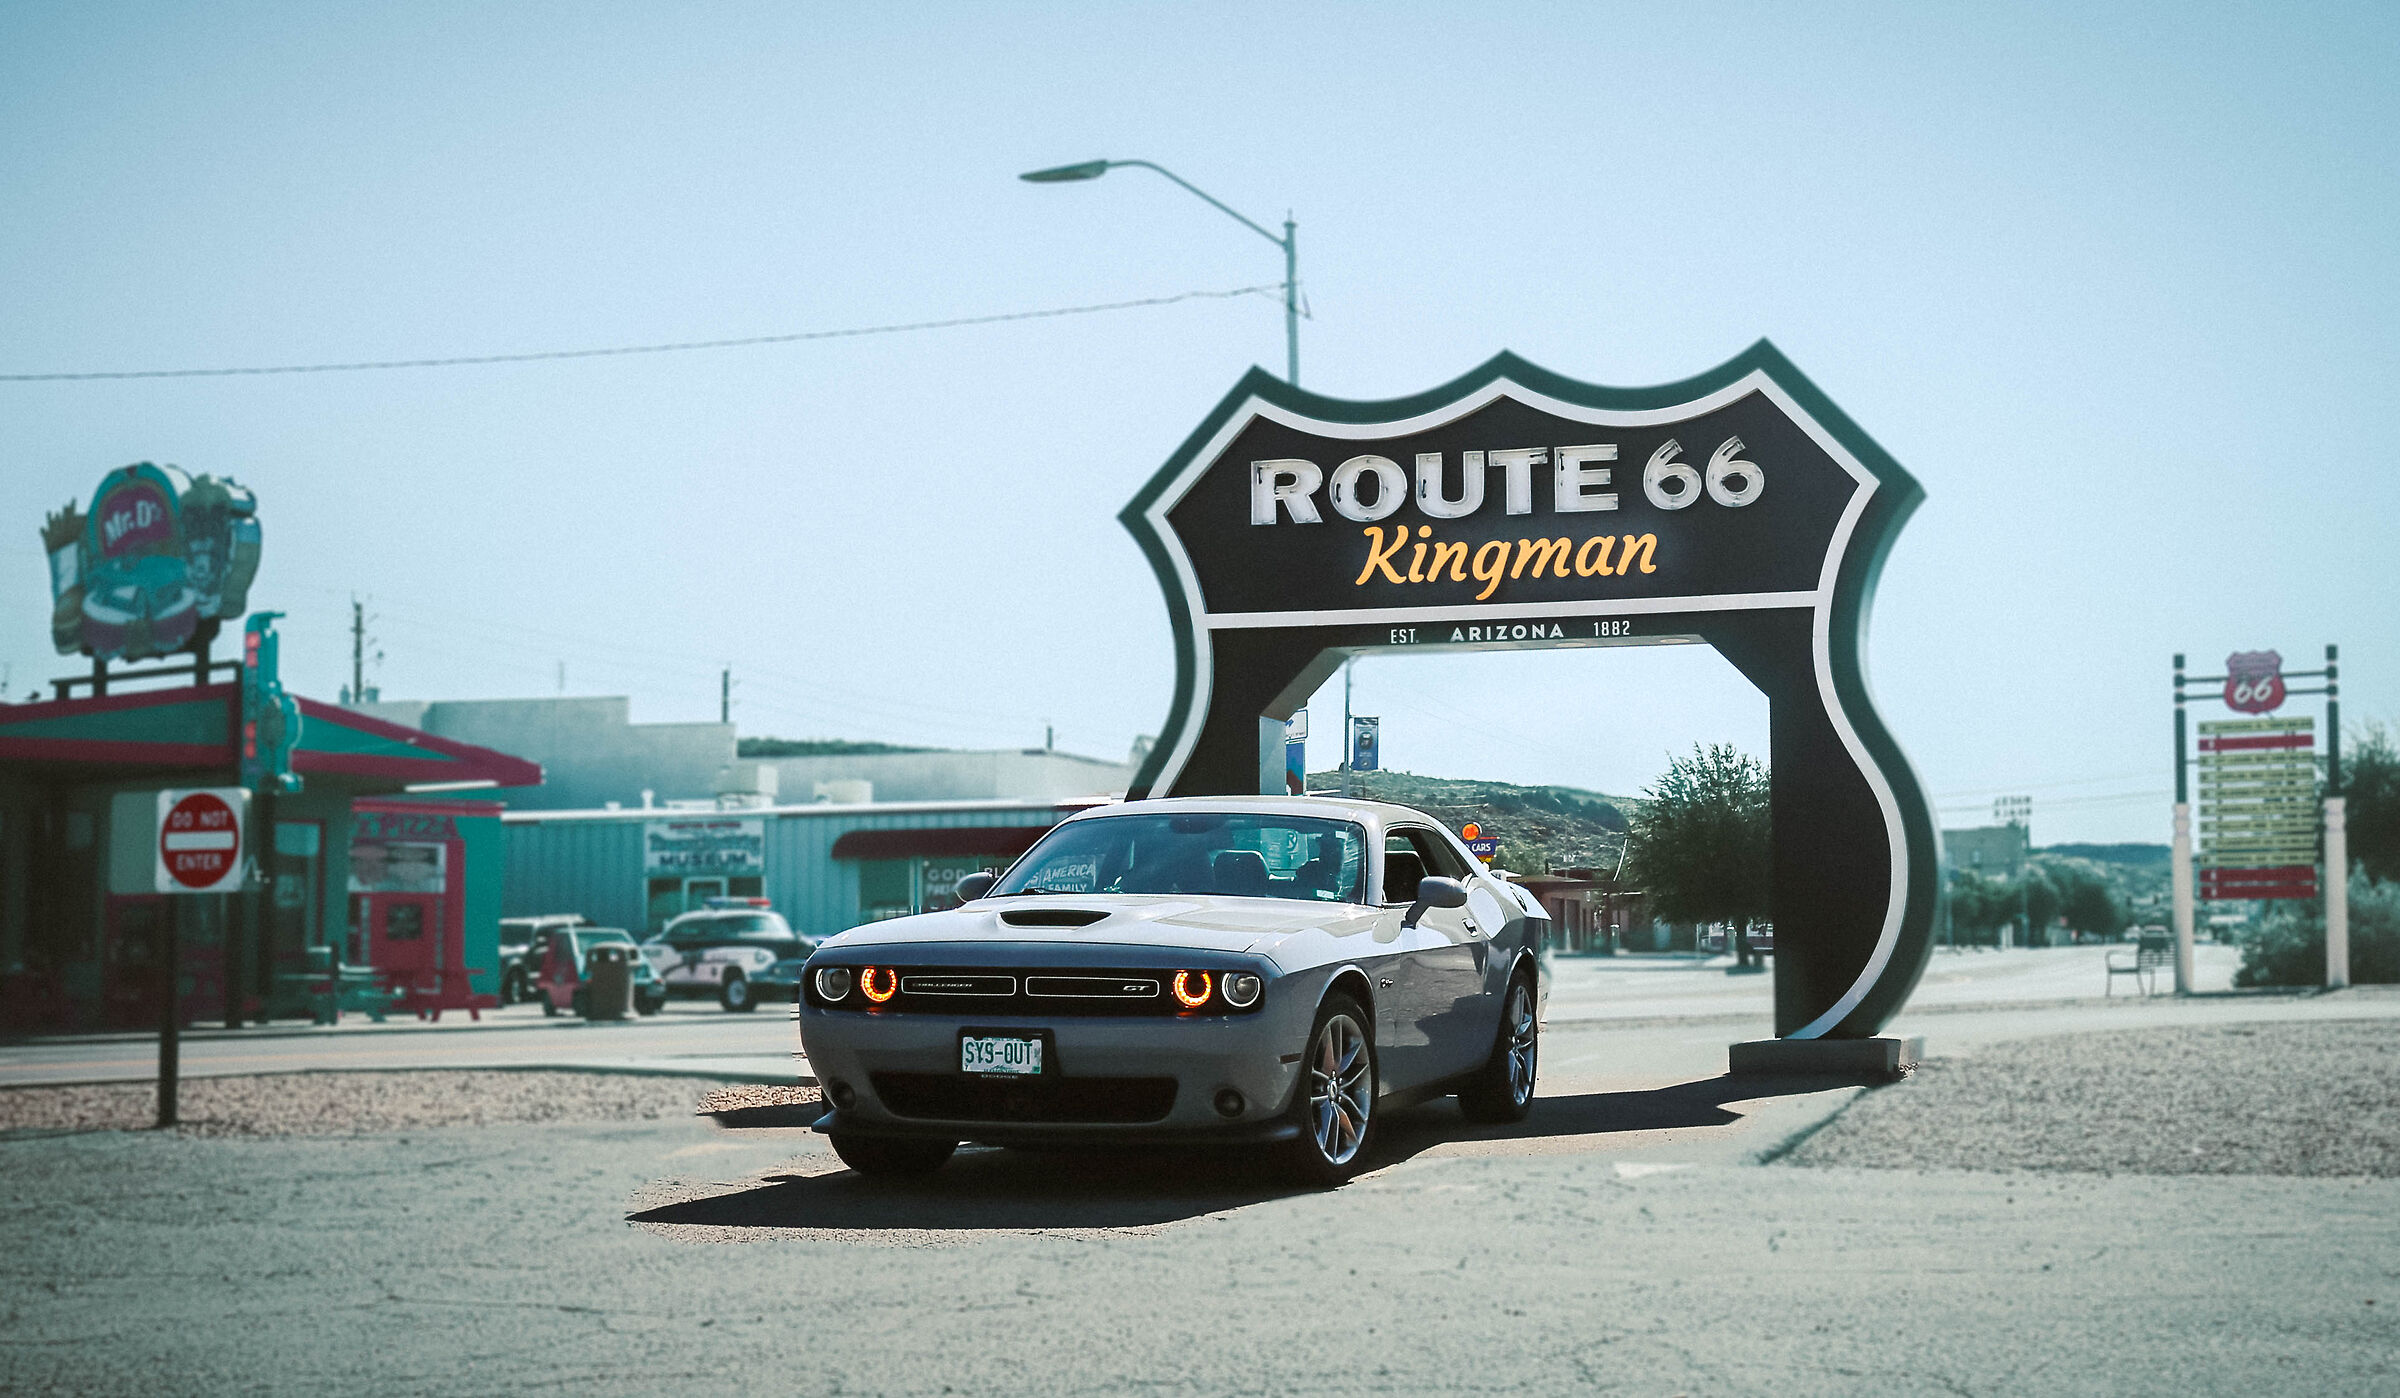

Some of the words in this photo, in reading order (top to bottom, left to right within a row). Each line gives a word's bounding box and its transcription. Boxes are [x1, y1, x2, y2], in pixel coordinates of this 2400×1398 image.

[1250, 443, 1619, 526] ROUTE
[1643, 435, 1765, 510] 66
[104, 510, 135, 548] Mr.
[1355, 525, 1658, 601] Kingman
[1390, 628, 1420, 644] EST.
[1450, 623, 1564, 643] ARIZONA
[1593, 620, 1630, 637] 1882
[2233, 676, 2273, 705] 66
[171, 811, 193, 828] DO
[200, 810, 228, 827] NOT
[1471, 843, 1491, 852] CARS
[176, 853, 222, 871] ENTER
[659, 852, 747, 866] MUSEUM
[927, 868, 967, 882] GOD
[1043, 863, 1096, 882] AMERICA
[1048, 883, 1087, 893] FAMILY
[1122, 984, 1150, 992] GT
